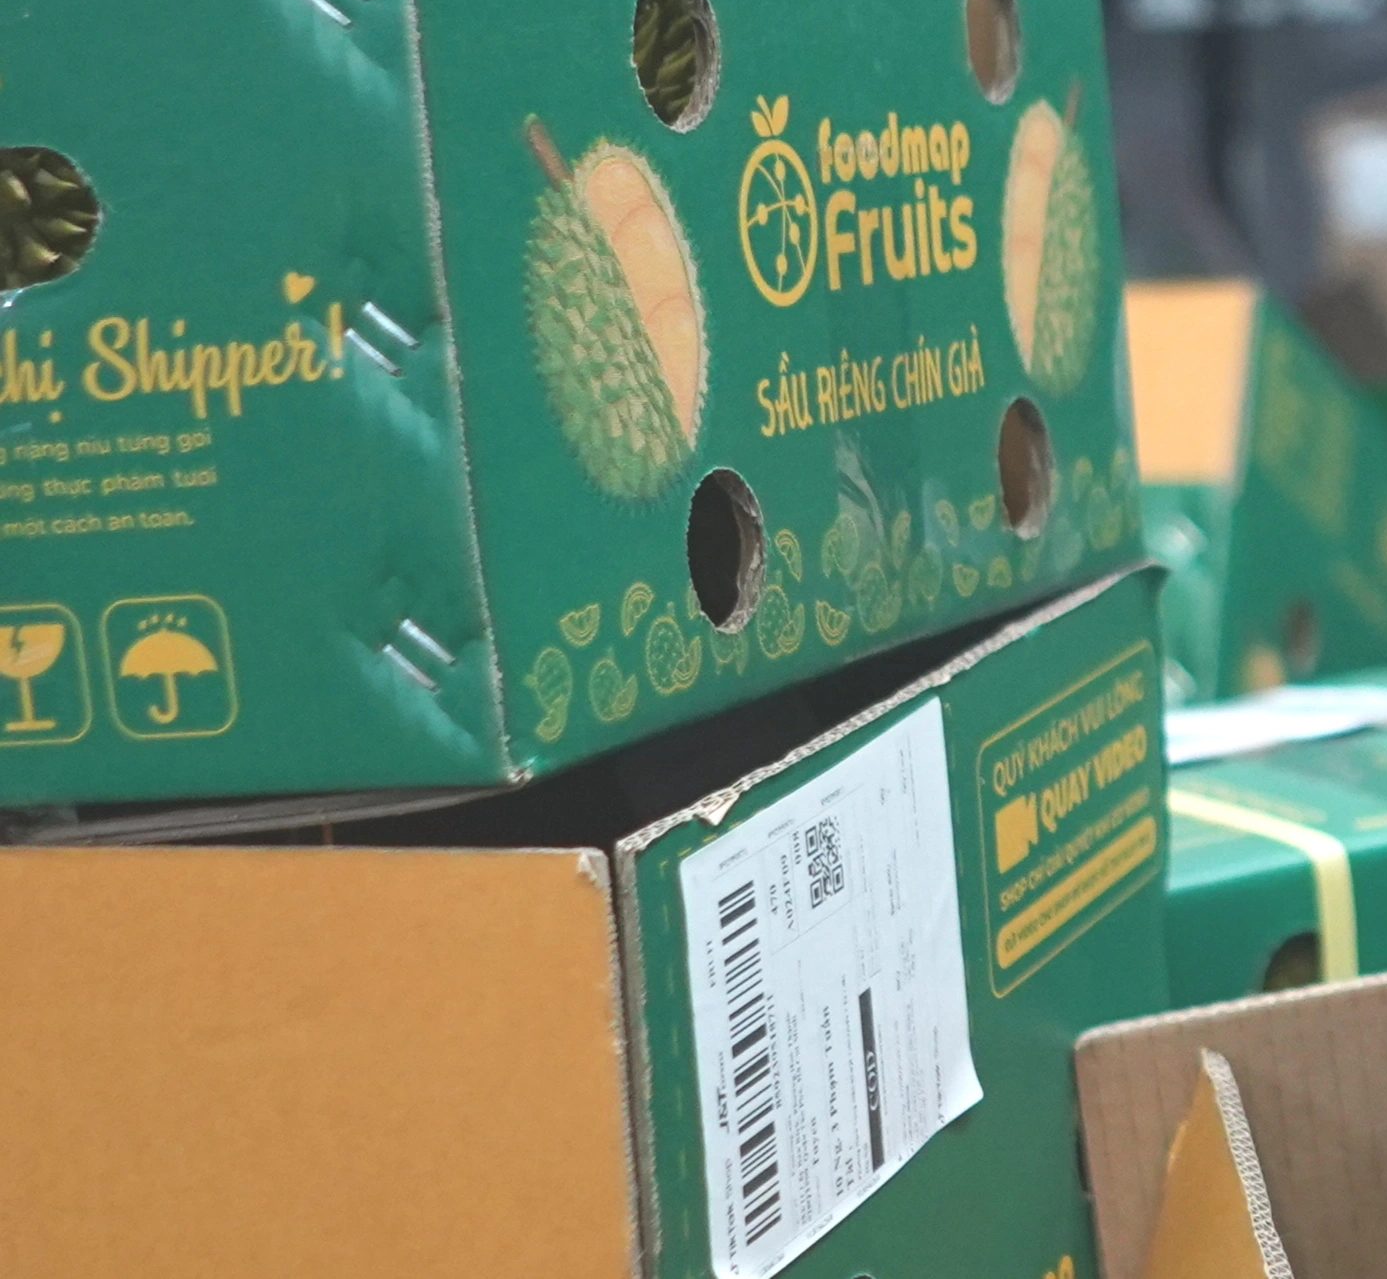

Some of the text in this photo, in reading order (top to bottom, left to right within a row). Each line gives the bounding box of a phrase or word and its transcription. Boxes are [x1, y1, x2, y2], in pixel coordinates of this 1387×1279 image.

[818, 111, 971, 185] foodmap
[82, 301, 345, 419] Shipper!
[757, 323, 984, 437] SẦU RIÊNG CHÍN GIÀ
[1041, 724, 1147, 834] QUAY VIDEO
